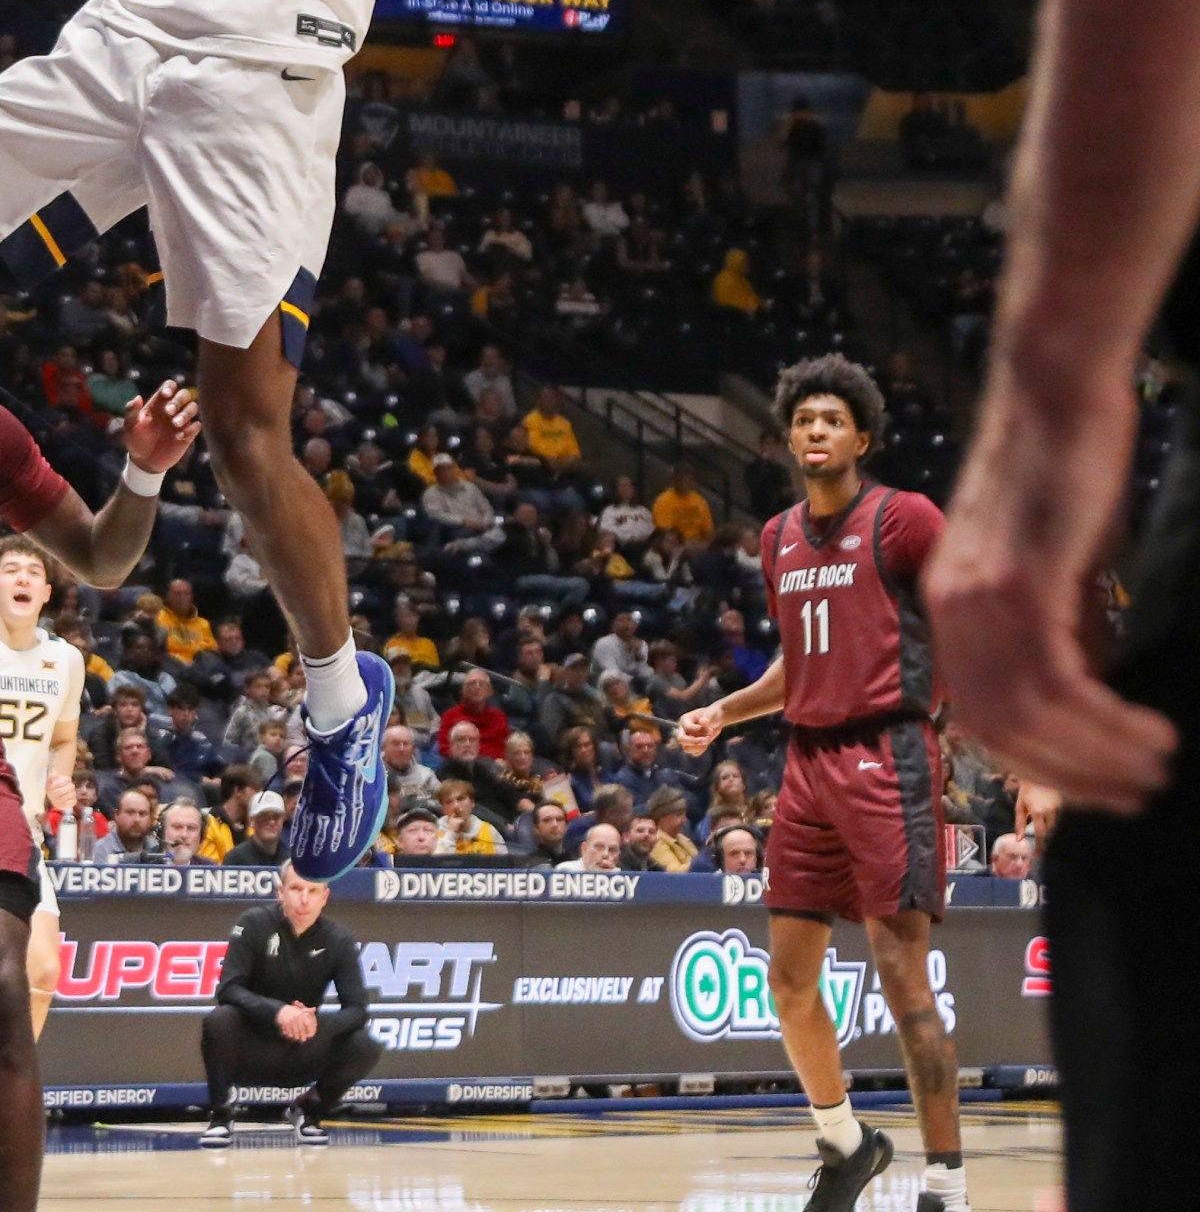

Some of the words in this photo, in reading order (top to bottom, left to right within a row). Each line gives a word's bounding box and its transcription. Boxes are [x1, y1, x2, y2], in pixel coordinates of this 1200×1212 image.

[491, 0, 535, 19] Online
[778, 567, 818, 596] LITTLE
[817, 562, 858, 589] ROCK
[800, 598, 830, 656] 11
[50, 867, 182, 894] VERSIFIED
[401, 871, 545, 899] DIVERSIFIED
[549, 873, 640, 901] ENERGY
[56, 932, 229, 999] UPER
[356, 942, 495, 998] ART
[513, 976, 634, 1004] EXCLUSIVELY
[637, 976, 664, 1004] AT
[367, 1018, 466, 1051] RIES
[43, 1089, 93, 1106] SIFIED
[97, 1089, 156, 1105] ENERGY
[463, 1084, 533, 1101] DIVERSIFIE
